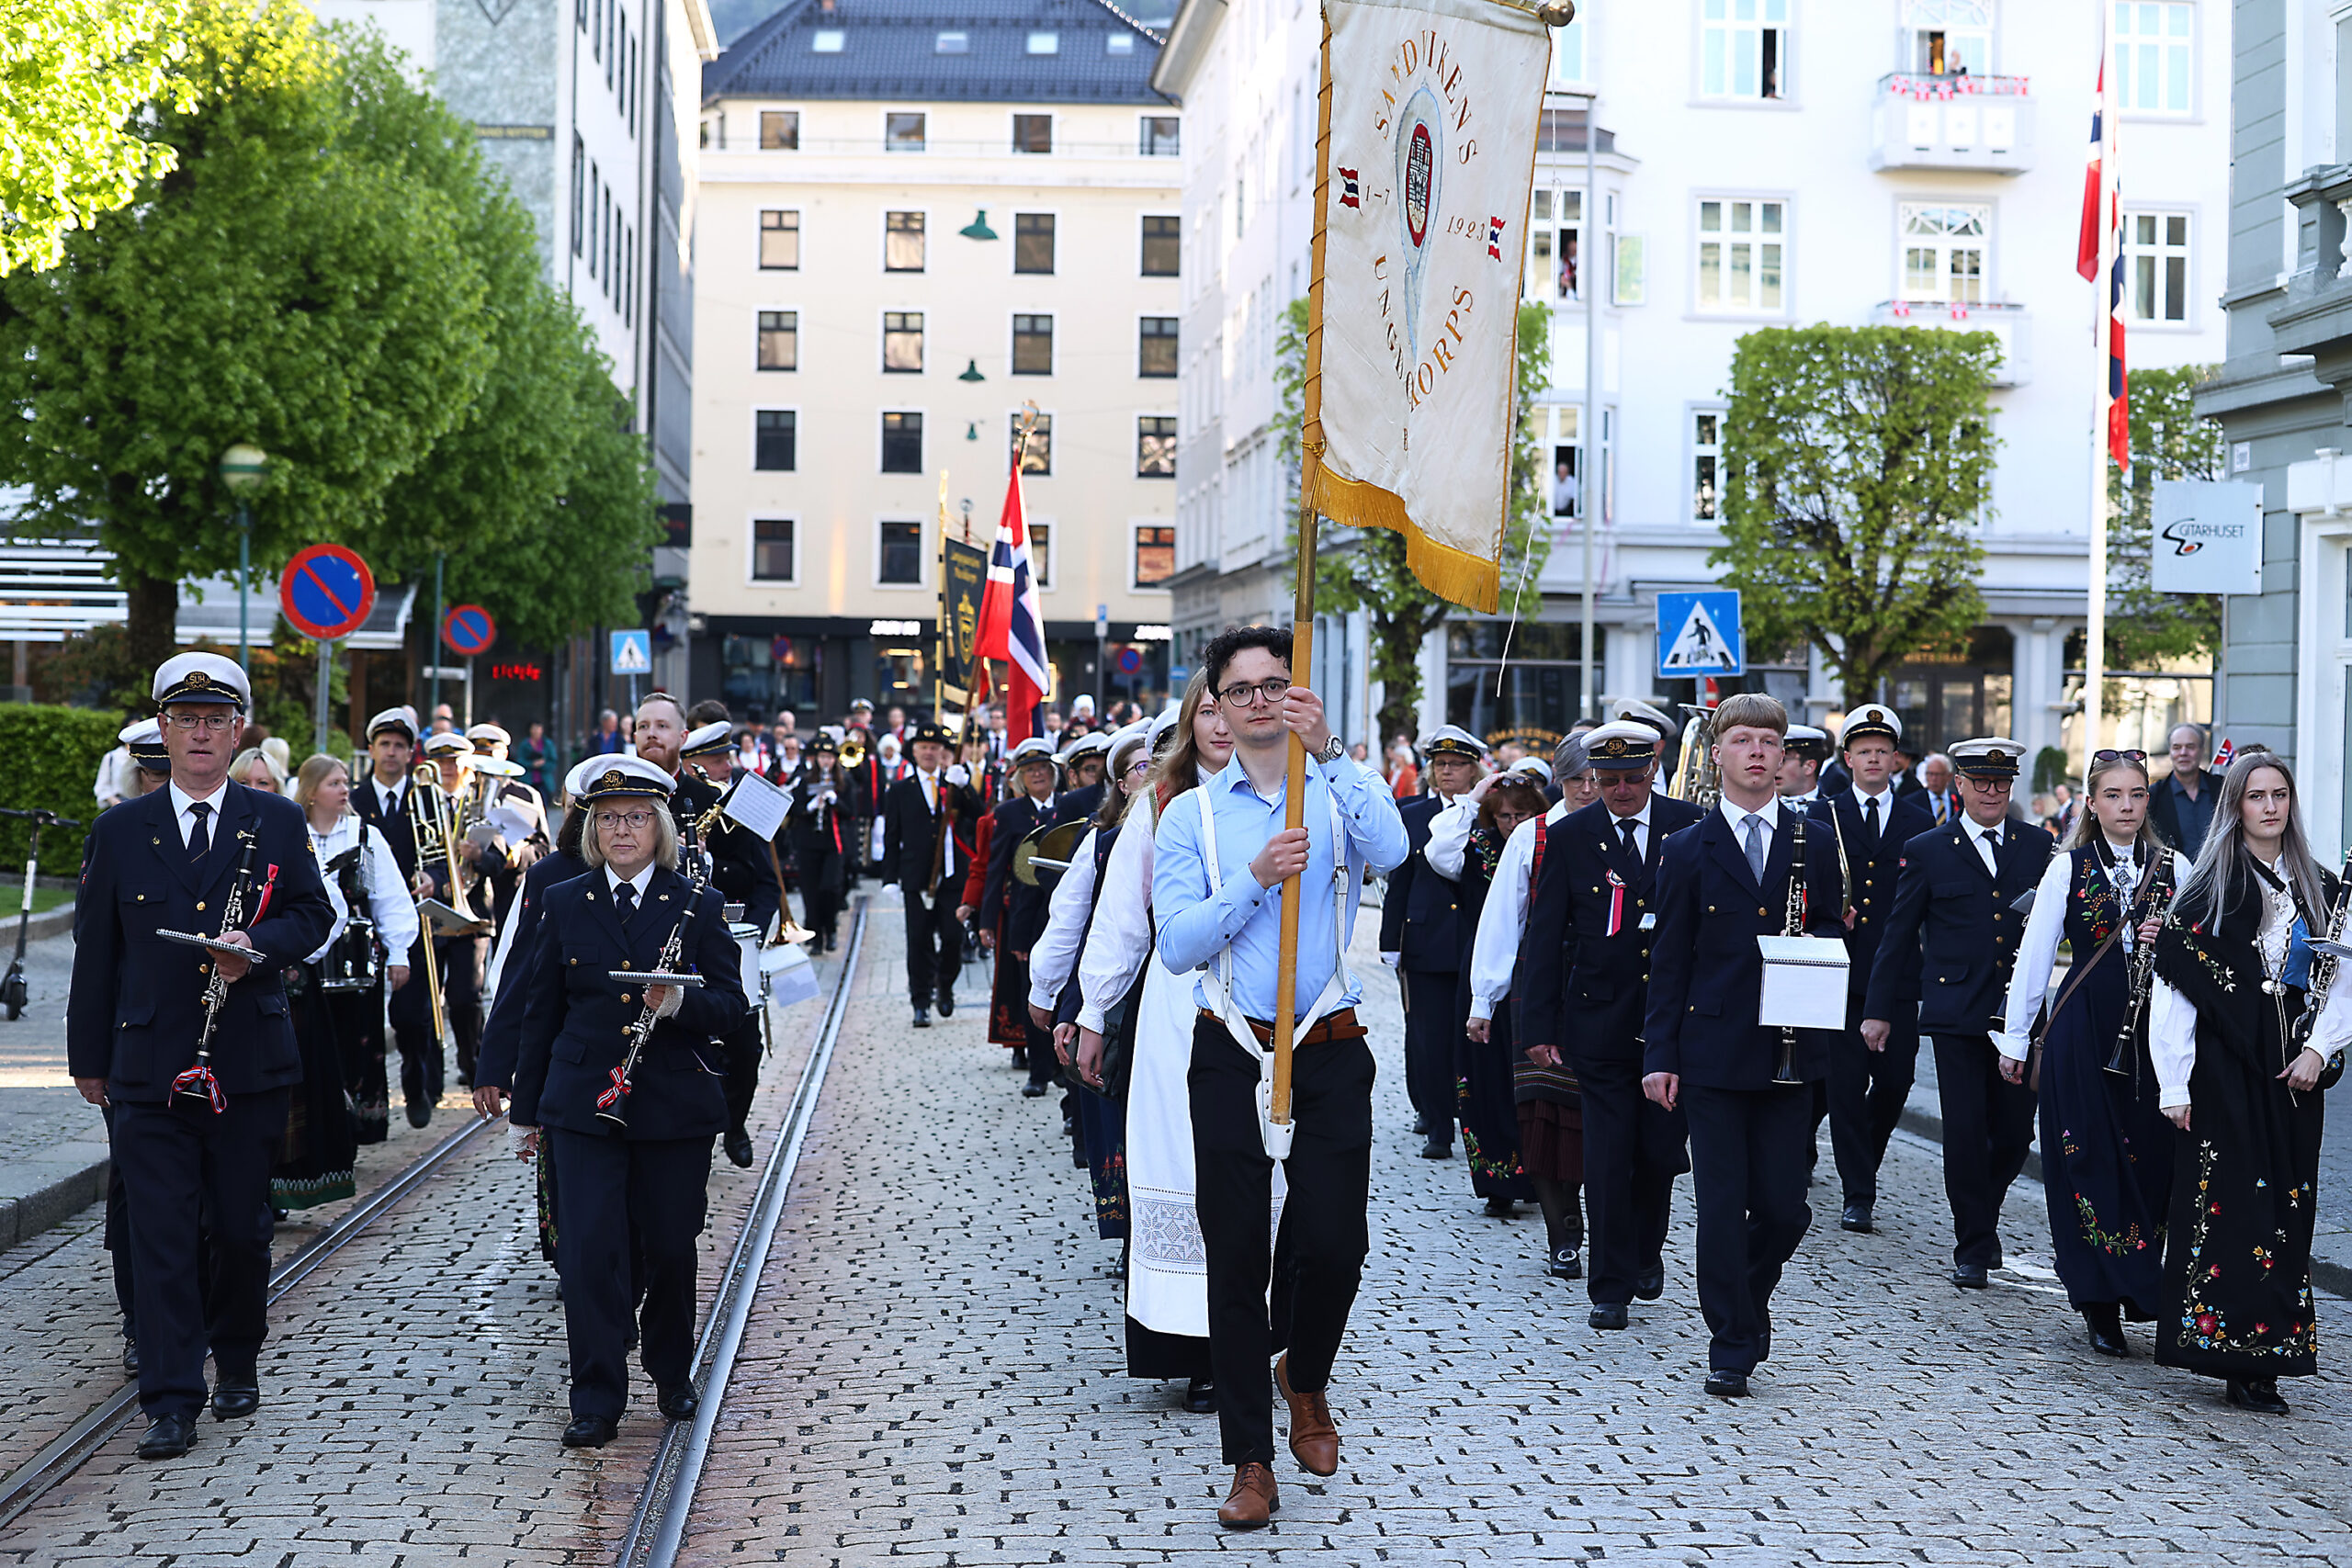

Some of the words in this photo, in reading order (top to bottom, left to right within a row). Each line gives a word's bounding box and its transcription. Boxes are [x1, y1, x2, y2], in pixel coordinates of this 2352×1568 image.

[1365, 185, 1390, 205] 1-7
[1447, 215, 1486, 242] 1923
[2178, 524, 2245, 538] GITARHUSET
